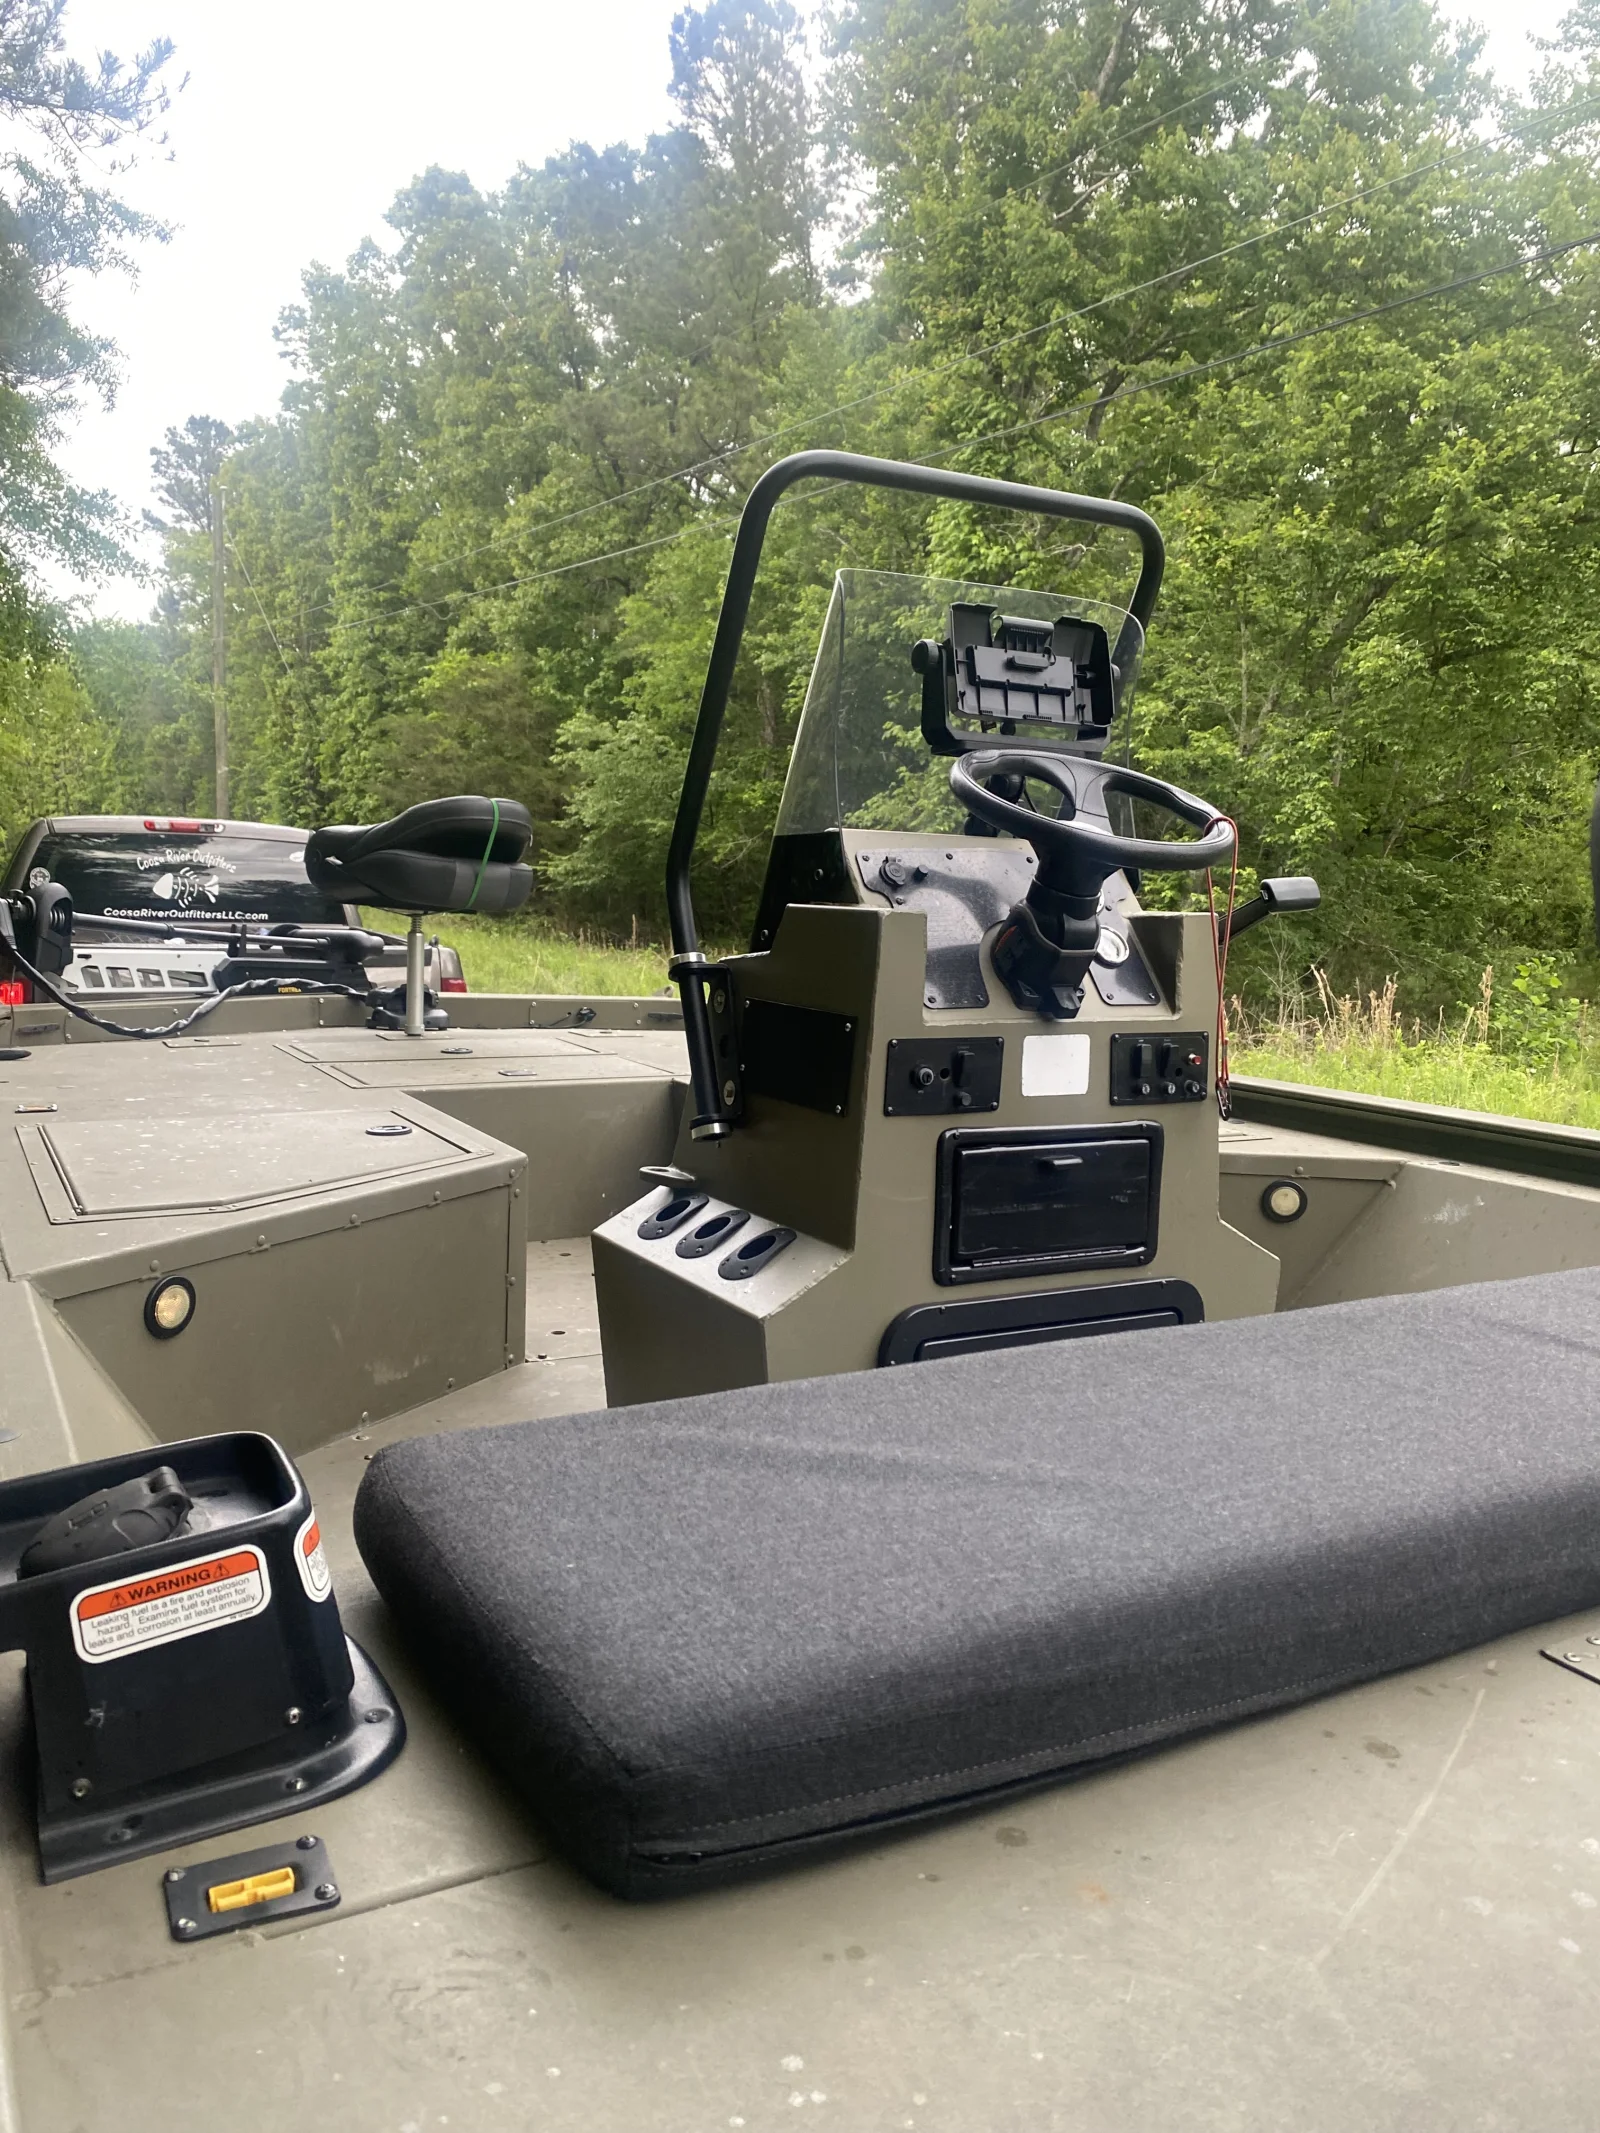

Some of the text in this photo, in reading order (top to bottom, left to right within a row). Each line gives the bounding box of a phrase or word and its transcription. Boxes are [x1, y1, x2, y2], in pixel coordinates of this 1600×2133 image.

[137, 849, 236, 873] Coosa River Outfitters
[103, 907, 269, 920] CoosaRiverOutfittersLLC.com
[91, 1611, 130, 1629] Leaking
[131, 1605, 149, 1617] fuel
[151, 1603, 159, 1611] is
[169, 1594, 185, 1606] fire
[187, 1589, 204, 1602] and
[207, 1576, 250, 1597] explosion
[128, 1569, 211, 1601] WARNING
[138, 1608, 179, 1625] Examine
[181, 1601, 199, 1613] fuel
[200, 1593, 232, 1610] system
[234, 1587, 247, 1598] for
[88, 1635, 115, 1649] leaks
[116, 1629, 135, 1642] and
[137, 1615, 183, 1635] corrosion
[184, 1611, 193, 1621] at
[194, 1604, 217, 1618] least
